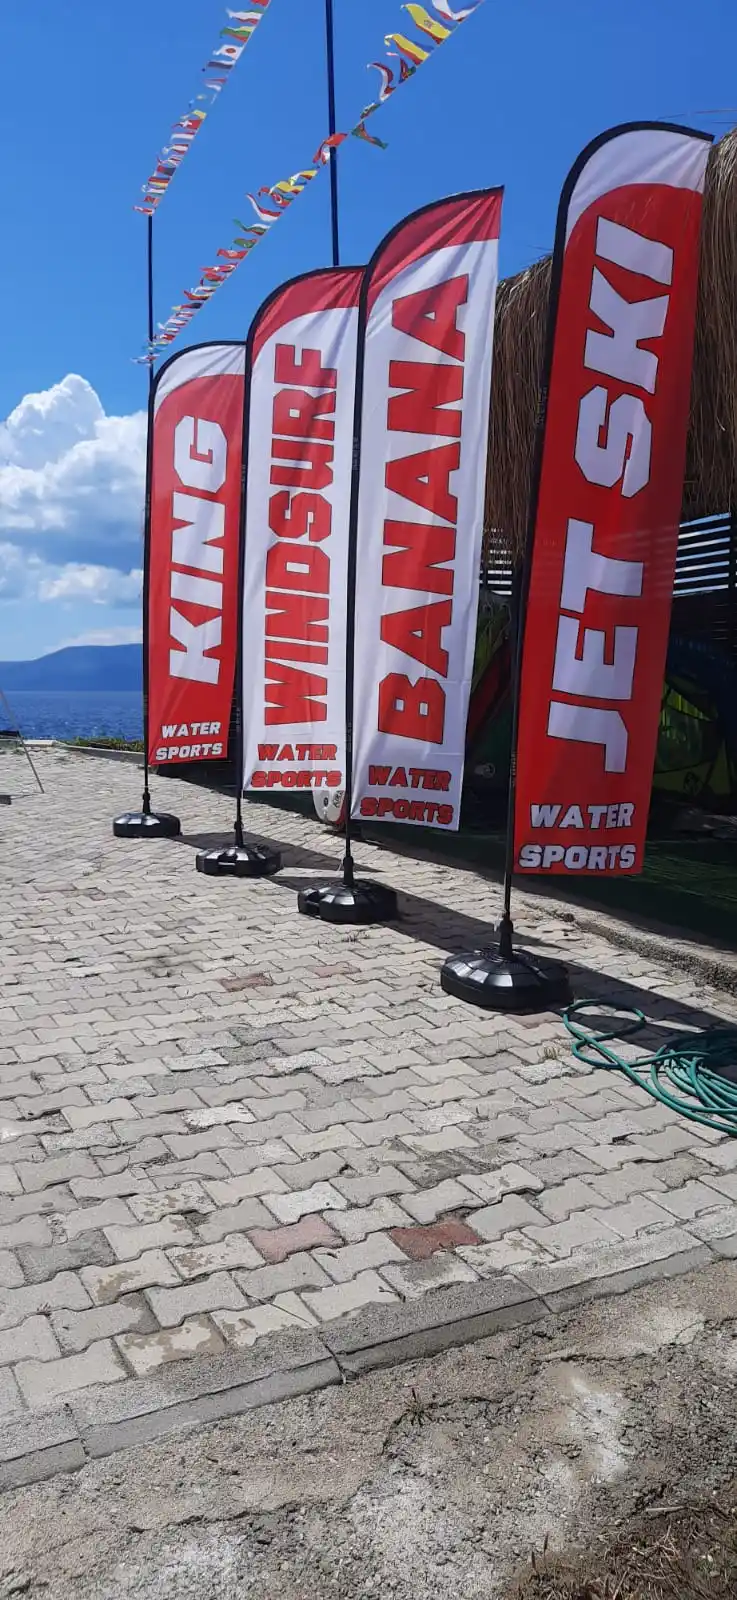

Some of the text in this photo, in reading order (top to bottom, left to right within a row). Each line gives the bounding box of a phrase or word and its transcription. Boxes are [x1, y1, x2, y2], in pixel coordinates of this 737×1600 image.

[377, 274, 468, 744] BANANA
[547, 216, 675, 774] JET SKI
[263, 342, 338, 726] WINDSURF
[169, 414, 228, 686] KING
[160, 721, 221, 738] WATER
[155, 742, 223, 762] SPORTS
[257, 743, 338, 762] WATER
[250, 769, 342, 788] SPORTS
[367, 764, 452, 792] WATER
[359, 797, 454, 826] SPORTS
[529, 802, 635, 829] WATER
[519, 843, 637, 871] SPORTS
